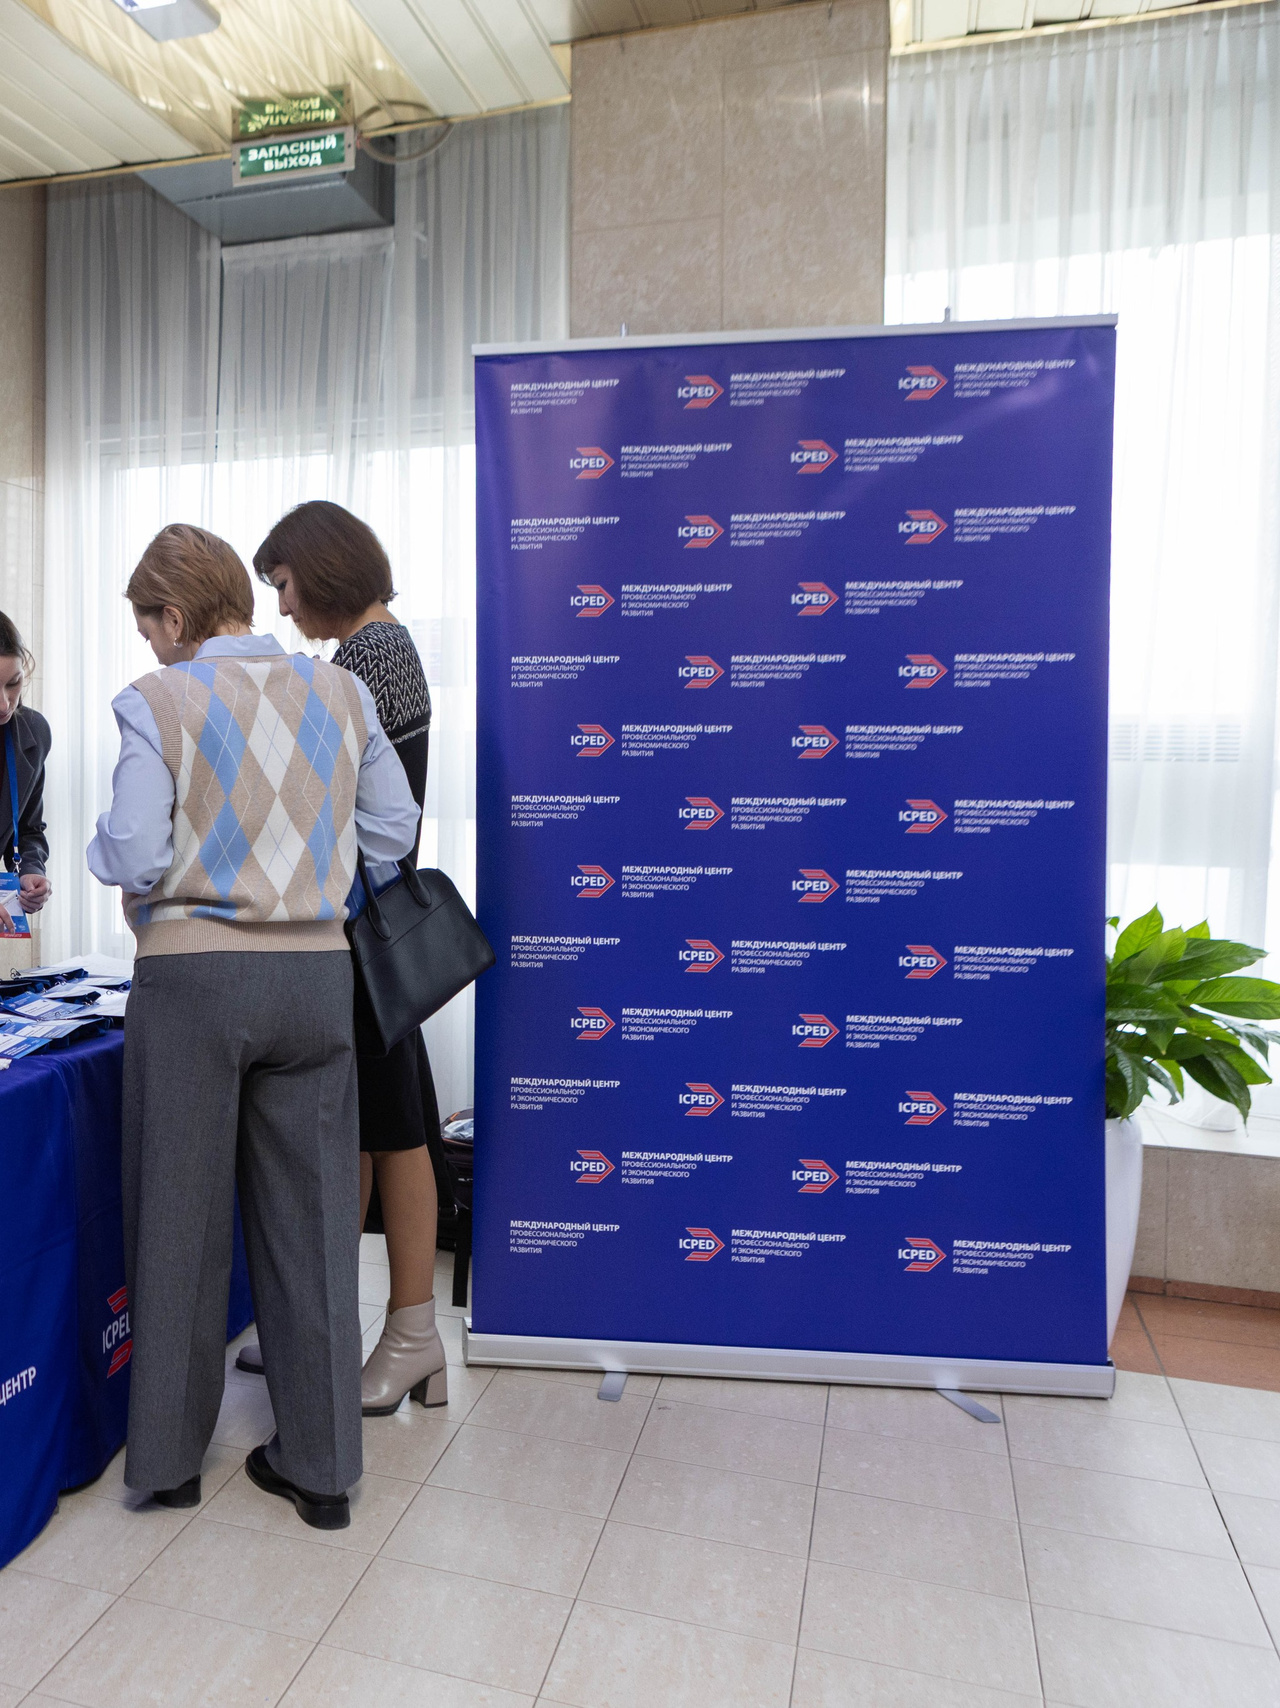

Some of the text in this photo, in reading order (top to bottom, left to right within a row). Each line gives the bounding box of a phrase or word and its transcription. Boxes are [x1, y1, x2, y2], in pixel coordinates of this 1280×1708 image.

[248, 134, 337, 161] ЗАПАСНЫЙ
[264, 152, 322, 172] ВЫХОД
[730, 369, 846, 382] МЕЖДУНАРОДНЫЙ ЦЕНТР
[511, 378, 619, 391] МЕЖДУНАРОДНЫЙ ЦЕНТР
[898, 376, 937, 389] ICPED
[678, 385, 714, 398] ICPED
[621, 443, 732, 454] МЕЖДУНАРОДНЫЙ ЦЕНТР
[791, 451, 829, 463] ICPED
[570, 458, 605, 468] ICPED
[511, 516, 620, 527] МЕЖДУНАРОДНЫЙ ЦЕНТР
[730, 511, 846, 522] МЕЖДУНАРОДНЫЙ ЦЕНТР
[511, 526, 584, 534] ПРОФЕССИОНАЛЬНОГО
[678, 526, 715, 537] ICPED
[898, 521, 937, 533] ICPED
[621, 583, 732, 593] МЕЖДУНАРОДНЫЙ ЦЕНТР
[571, 596, 606, 606] ICPED
[791, 594, 829, 604] ICPED
[511, 655, 620, 664] МЕЖДУНАРОДНЫЙ ЦЕНТР
[731, 654, 846, 664] МЕЖДУНАРОДНЫЙ ЦЕНТР
[678, 667, 715, 677] ICPED
[898, 666, 937, 677] ICPED
[622, 724, 733, 733] МЕЖДУНАРОДНЫЙ ЦЕНТР
[845, 724, 963, 734] МЕЖДУНАРОДНЫЙ ЦЕНТР
[571, 735, 606, 745] ICPED
[622, 733, 696, 741] ПРОФЕССИОНАЛЬНОГО
[792, 737, 829, 747] ICPED
[511, 795, 591, 803] МЕЖДУНАРОДНЫЙ
[731, 797, 847, 806] МЕЖДУНАРОДНЫЙ ЦЕНТР
[511, 803, 585, 811] ПРОФЕССИОНАЛЬНОГО
[679, 808, 716, 818] ICPED
[899, 811, 937, 821] ICPED
[622, 866, 733, 876] МЕЖДУНАРОДНЫЙ ЦЕНТР
[846, 870, 963, 880] МЕЖДУНАРОДНЫЙ ЦЕНТР
[571, 876, 606, 887] ICPED
[622, 874, 697, 882] ПРОФЕССИОНАЛЬНОГО
[628, 883, 689, 891] ЭКОНОМИЧЕСКОГО
[792, 880, 829, 891] ICPED
[511, 936, 620, 945] МЕЖДУНАРОДНЫЙ ЦЕНТР
[731, 940, 847, 951] МЕЖДУНАРОДНЫЙ ЦЕНТР
[517, 953, 578, 961] ЭКОНОМИЧЕСКОГО
[679, 950, 716, 961] ICPED
[954, 946, 1074, 958] МЕЖДУНАРОДНЫЙ ЦЕНТР
[899, 956, 937, 967] ICPED
[622, 1008, 733, 1019] МЕЖДУНАРОДНЫЙ ЦЕНТР
[571, 1018, 606, 1029] ICPED
[622, 1017, 697, 1025] ПРОФЕССИОНАЛЬНОГО
[846, 1015, 963, 1026] МЕЖДУНАРОДНЫЙ ЦЕНТР
[792, 1025, 829, 1036] ICPED
[511, 1077, 620, 1088] МЕЖДУНАРОДНЫЙ ЦЕНТР
[511, 1087, 585, 1095] ПРОФЕССИОНАЛЬНОГО
[731, 1084, 847, 1096] МЕЖДУНАРОДНЫЙ ЦЕНТР
[517, 1095, 578, 1103] ЭКОНОМИЧЕСКОГО
[679, 1094, 716, 1105] ICPED
[731, 1094, 810, 1103] ПРОФЕССИОНАЛЬНОГО
[953, 1093, 1073, 1105] МЕЖДУНАРОДНЫЙ ЦЕНТР
[738, 1102, 802, 1111] ЭКОНОМИЧЕСКОГО
[898, 1102, 936, 1113] ICPED
[622, 1151, 733, 1163] МЕЖДУНАРОДНЫЙ ЦЕНТР
[570, 1161, 606, 1172] ICPED
[622, 1161, 697, 1169] ПРОФЕССИОНАЛЬНОГО
[846, 1161, 962, 1173] МЕЖДУНАРОДНЫЙ ЦЕНТР
[628, 1169, 690, 1178] ЭКОНОМИЧЕСКОГО
[792, 1170, 829, 1181] ICPED
[510, 1220, 620, 1232] МЕЖДУНАРОДНЫЙ ЦЕНТР
[510, 1230, 584, 1239] ПРОФЕССИОНАЛЬНОГО
[731, 1229, 846, 1243] МЕЖДУНАРОДНЫЙ ЦЕНТР
[516, 1238, 577, 1247] ЭКОНОМИЧЕСКОГО
[679, 1239, 715, 1250] ICPED
[953, 1240, 1071, 1253] МЕЖДУНАРОДНЫЙ ЦЕНТР
[898, 1249, 936, 1261] ICPED
